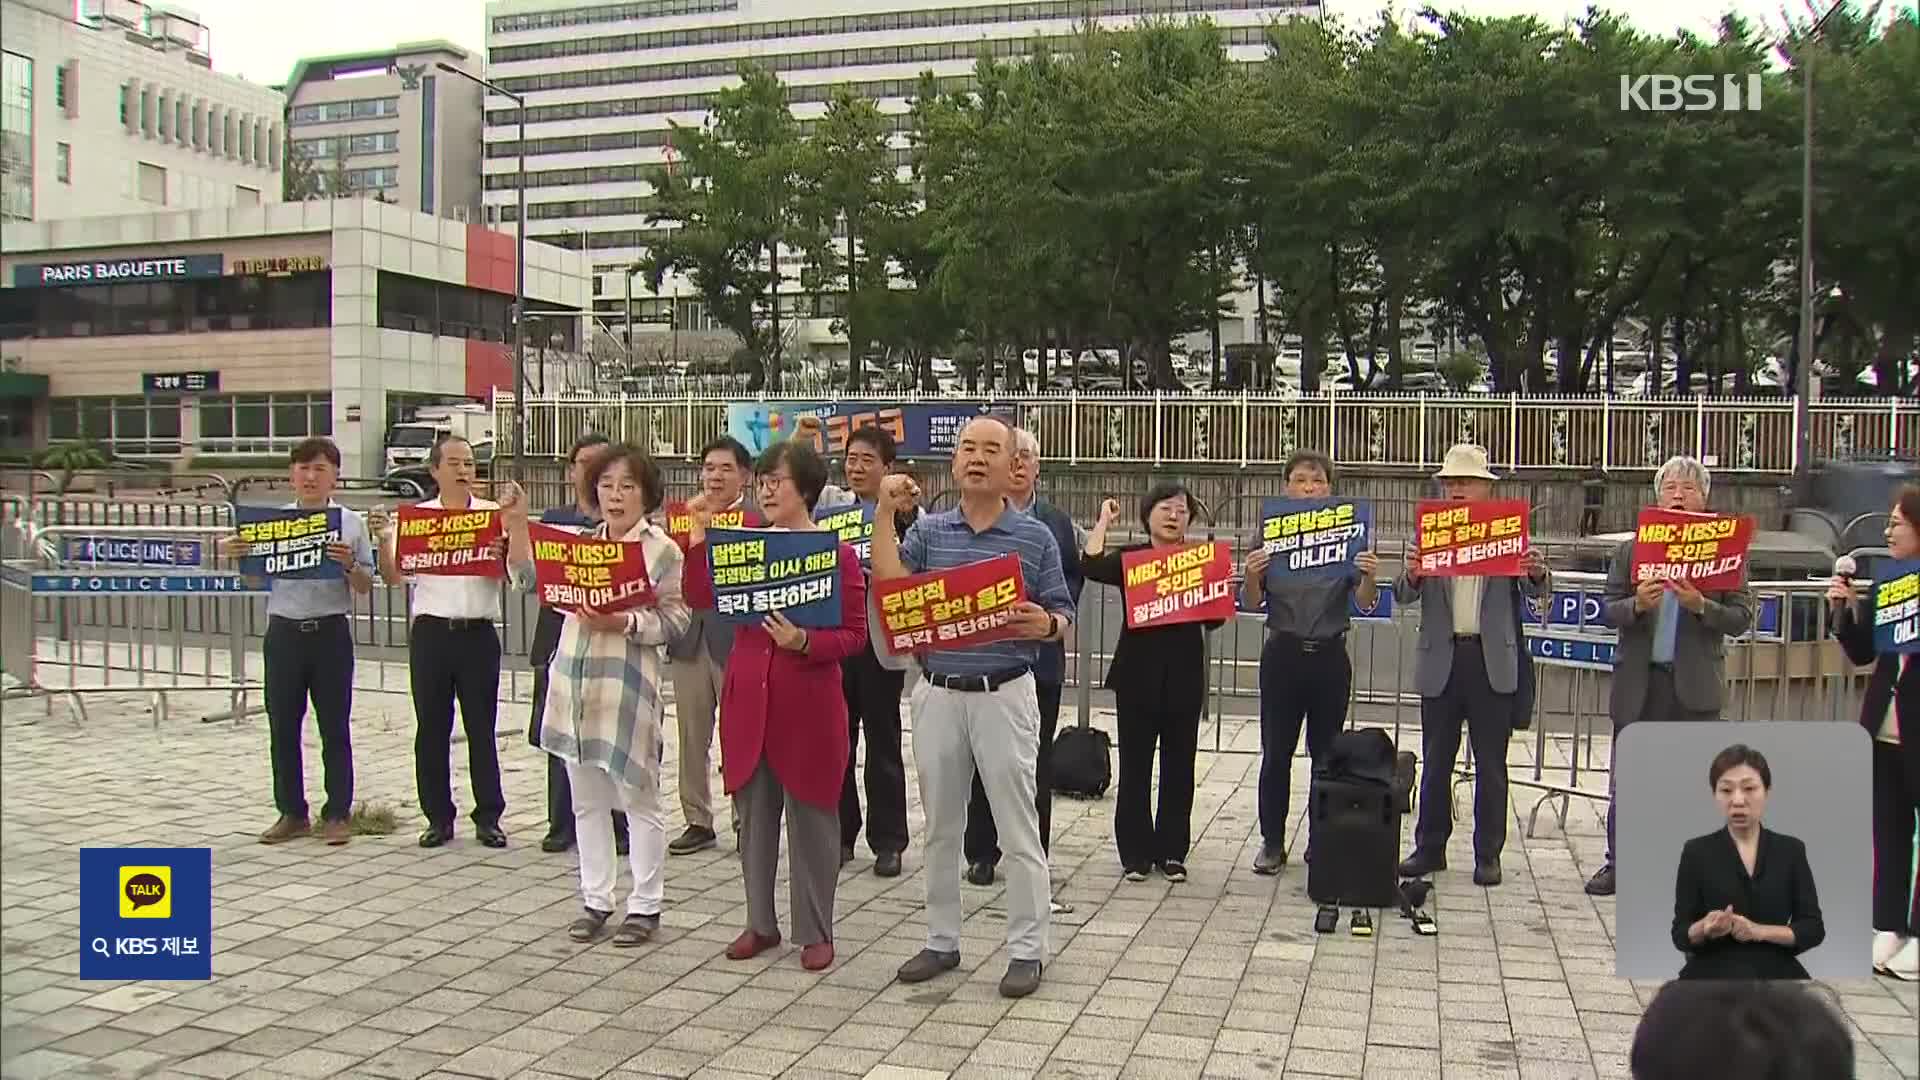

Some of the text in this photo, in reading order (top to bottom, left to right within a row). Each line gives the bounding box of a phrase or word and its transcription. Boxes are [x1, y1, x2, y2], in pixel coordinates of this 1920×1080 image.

[42, 259, 186, 281] PARIS BAGUETTE
[240, 512, 327, 542] 공영방송은
[1264, 504, 1354, 538] 공영방송은
[1421, 507, 1469, 529] 무법적
[428, 533, 475, 551] 주인은
[1421, 530, 1451, 549] 방송
[1456, 523, 1487, 542] 장악
[143, 543, 174, 560] LINE
[401, 551, 448, 569] 정권이
[712, 540, 764, 566] 탈법적
[1422, 552, 1453, 570] 즉각
[1666, 541, 1719, 561] 주인은
[564, 566, 611, 586] 주인은
[714, 551, 836, 585] 공영방송 이사 해임
[1637, 554, 1741, 580] 정권이 아니다
[72, 578, 241, 590] POLICE LINE
[543, 579, 646, 606] 정권이 아니다
[882, 578, 945, 611] 무법적
[1156, 568, 1203, 596] 주인은
[717, 576, 832, 615] 즉각 중단하라!
[1133, 580, 1229, 624] 정권이 아니다
[885, 610, 925, 631] 방송
[931, 595, 971, 622] 장악
[893, 629, 933, 649] 즉각
